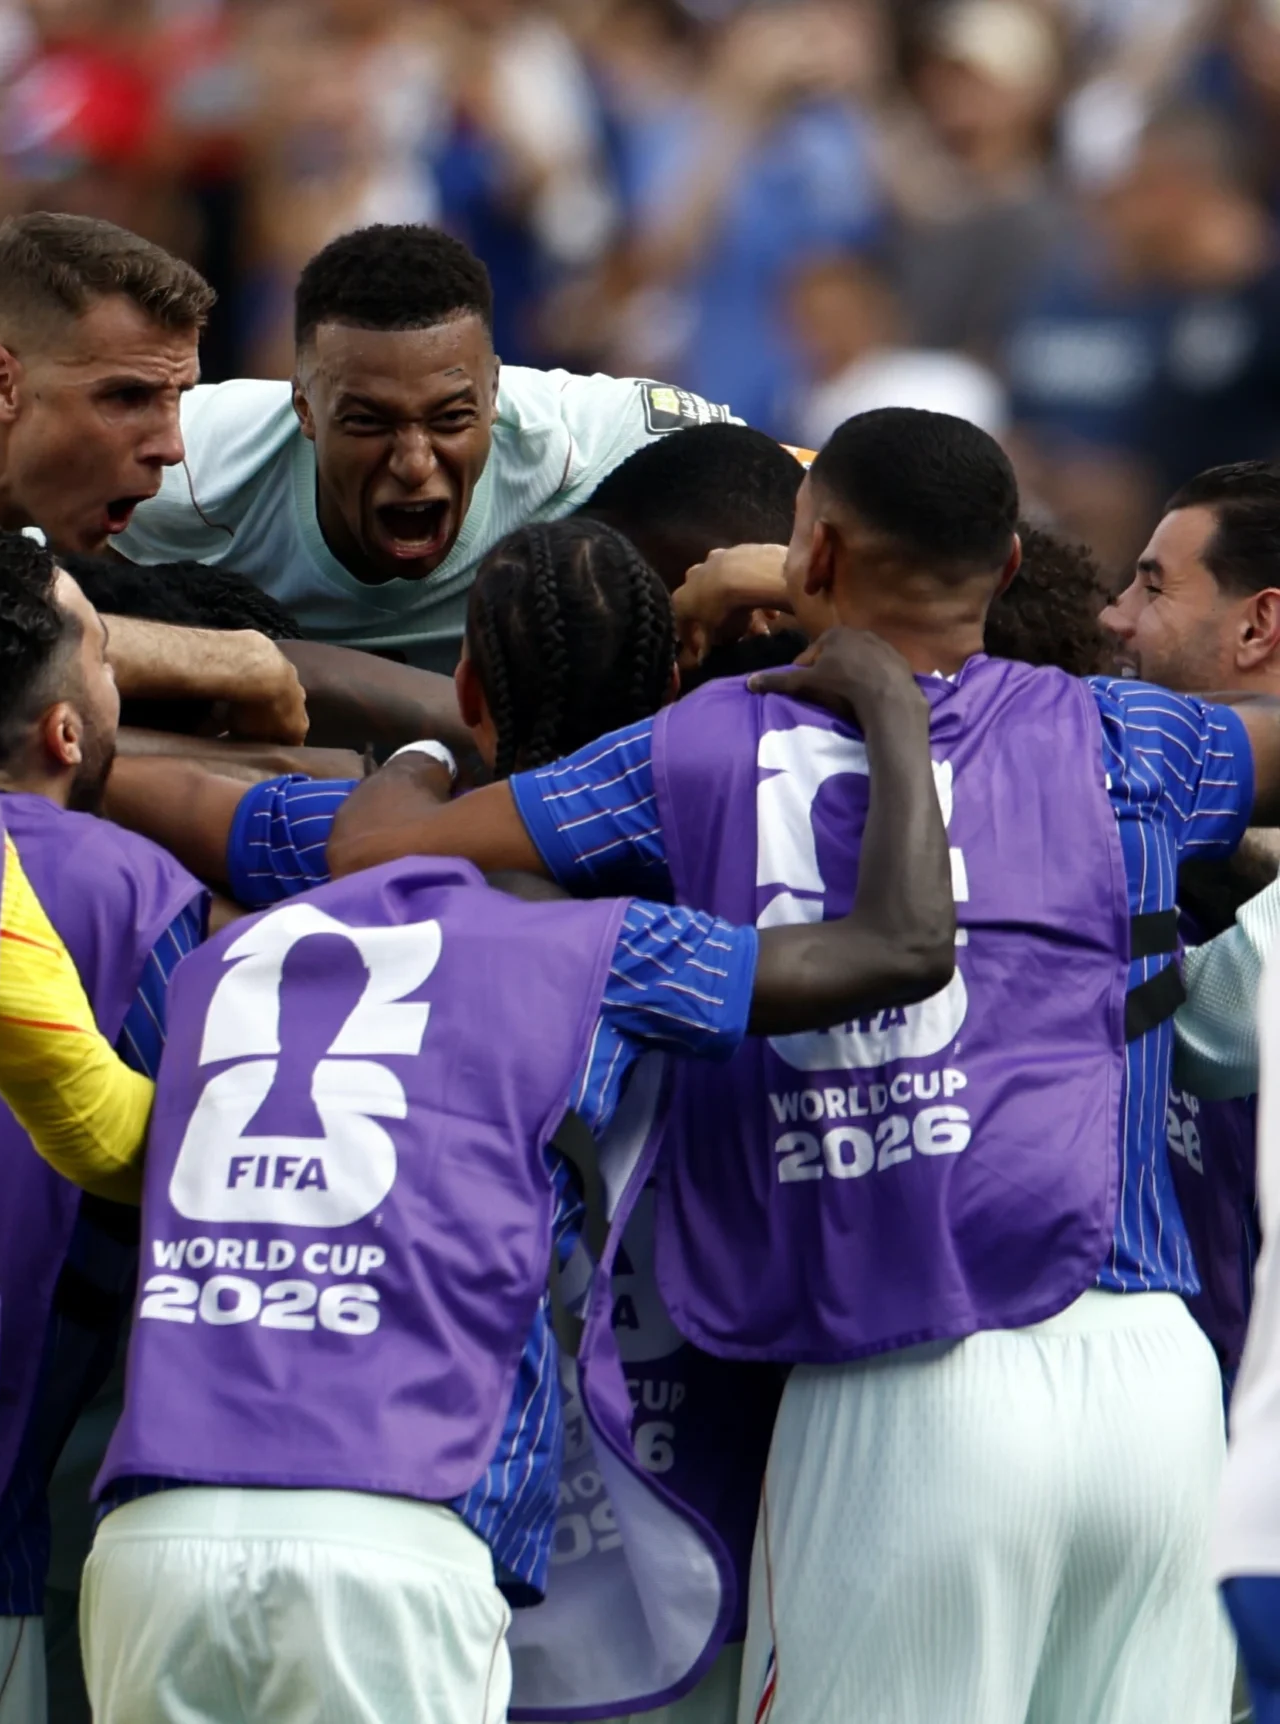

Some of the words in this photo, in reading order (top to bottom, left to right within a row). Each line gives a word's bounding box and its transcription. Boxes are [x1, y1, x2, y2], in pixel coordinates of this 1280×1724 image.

[768, 1084, 888, 1124] WORLD
[890, 1068, 968, 1104] CUP
[775, 1104, 971, 1183] 2026
[227, 1155, 329, 1191] FIFA
[152, 1237, 296, 1271] WORLD
[302, 1243, 387, 1276] CUP
[140, 1275, 381, 1336] 2026
